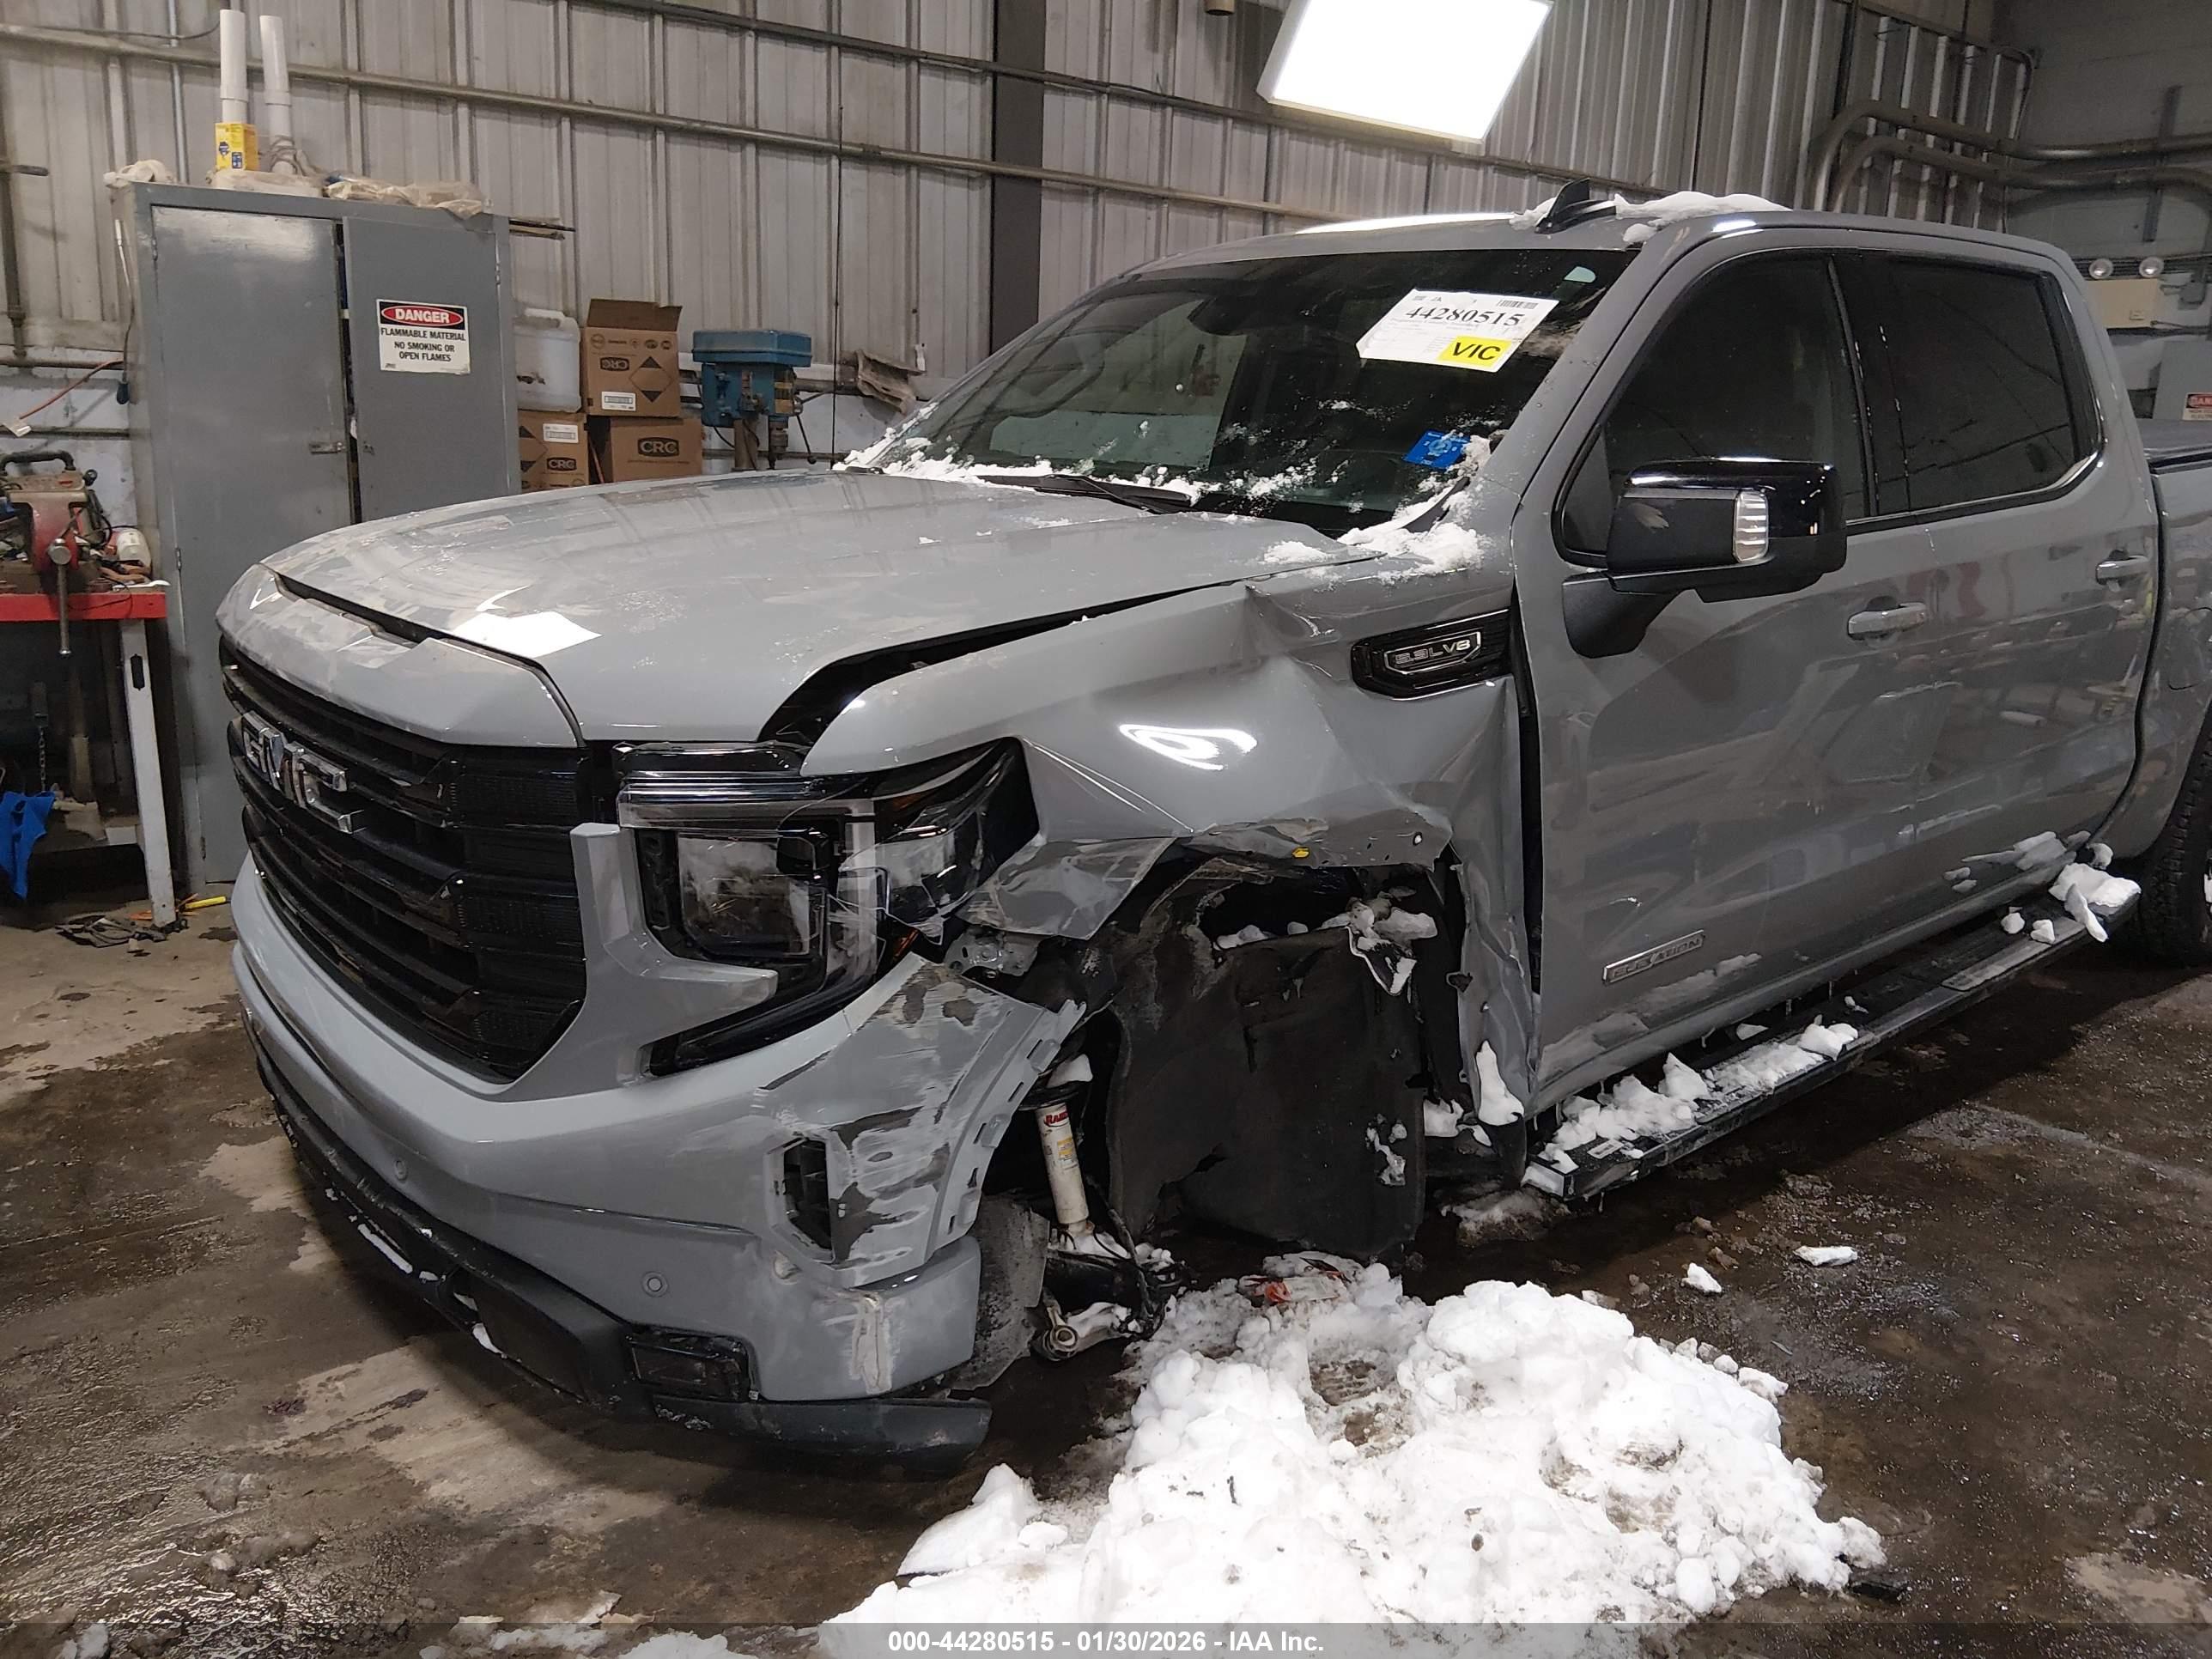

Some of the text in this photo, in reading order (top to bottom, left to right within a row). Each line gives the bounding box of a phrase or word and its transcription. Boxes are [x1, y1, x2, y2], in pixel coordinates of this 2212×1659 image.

[395, 308, 450, 323] DANGER
[1405, 307, 1526, 326] 44280515
[380, 327, 466, 341] FLAMMABLE MATERIAL
[394, 341, 405, 349] NO
[407, 342, 442, 352] SMOKING
[1452, 342, 1501, 361] VIC
[398, 351, 452, 362] OPEN FLAMES
[640, 441, 678, 453] CRC
[549, 459, 577, 469] CRC
[241, 711, 354, 835] GMC
